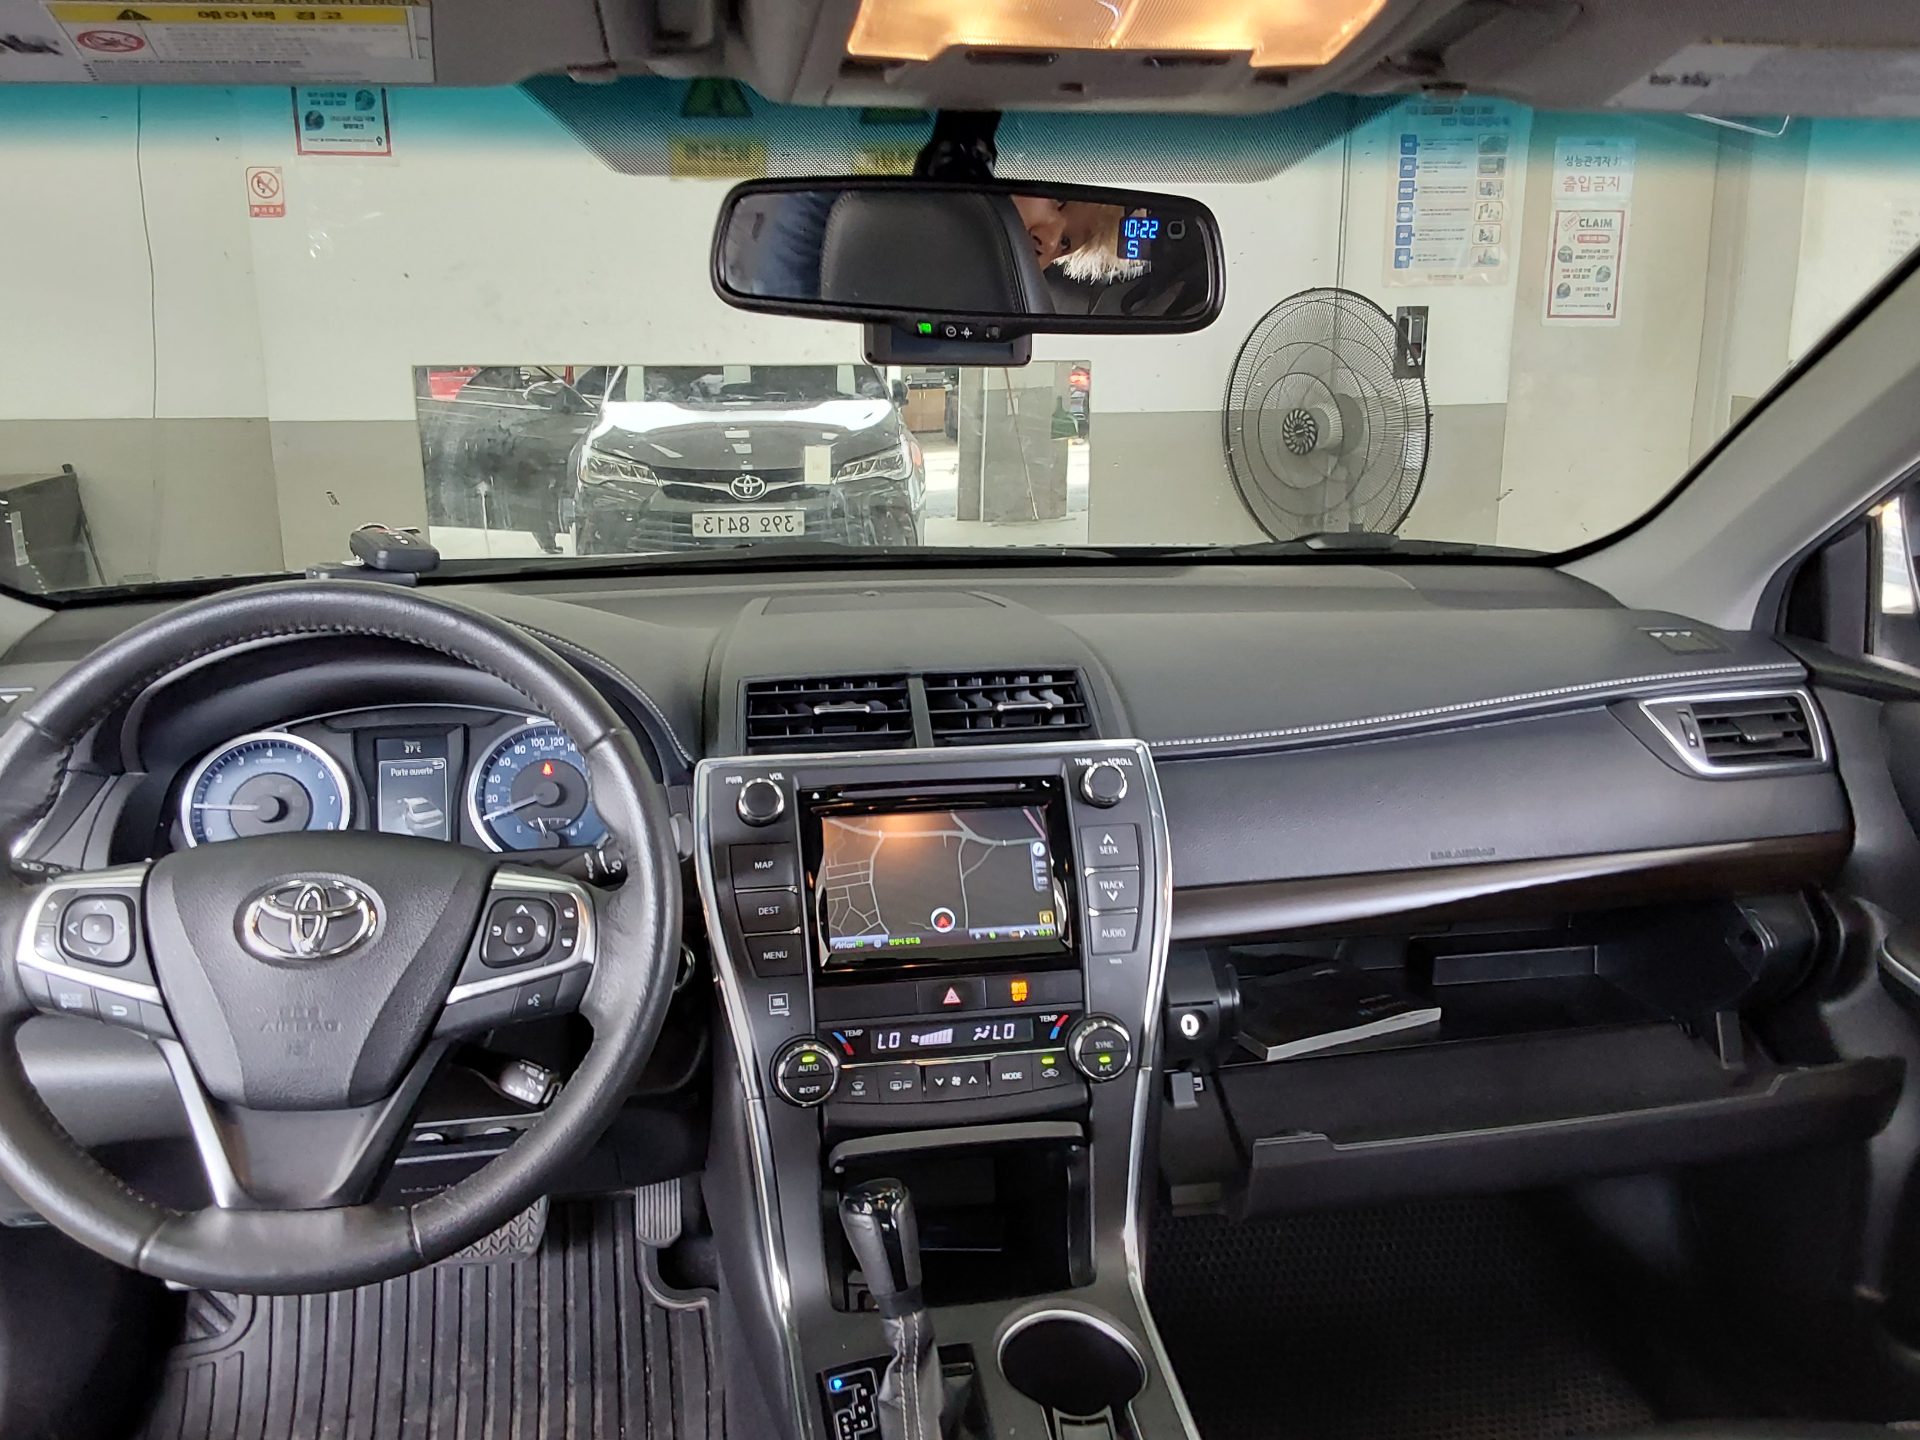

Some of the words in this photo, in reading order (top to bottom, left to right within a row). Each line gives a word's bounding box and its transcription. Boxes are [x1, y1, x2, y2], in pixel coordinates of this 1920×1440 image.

[1563, 175, 1620, 193] 출입금지
[1578, 218, 1613, 228] CLAIM
[1124, 219, 1159, 239] 10:22
[531, 738, 545, 747] 100
[551, 737, 564, 746] 120
[265, 749, 273, 758] 4
[514, 745, 526, 754] 80
[238, 757, 245, 766] 3
[296, 755, 302, 763] 5
[499, 757, 511, 766] 60
[318, 770, 324, 779] 6
[390, 767, 408, 777] Porte
[409, 766, 434, 776] ouverte
[769, 772, 784, 780] VOL
[216, 774, 223, 783] 2
[489, 775, 500, 784] 40
[328, 796, 336, 805] 7
[487, 794, 498, 803] 20
[1100, 846, 1119, 855] SEEK
[754, 861, 773, 869] MAP
[1099, 881, 1125, 890] TRACK
[758, 906, 780, 915] DEST
[1102, 928, 1126, 938] AUDIO
[763, 951, 788, 960] MENU
[845, 1029, 863, 1037] TEMP
[993, 1023, 1015, 1040] LO
[877, 1032, 900, 1049] LO
[1095, 1041, 1114, 1049] SYNC
[798, 1064, 819, 1072] AUTO
[1098, 1064, 1112, 1072] A/C
[1002, 1072, 1022, 1080] MODE
[806, 1086, 820, 1094] OFF
[858, 1405, 866, 1414] N
[861, 1419, 868, 1428] D
